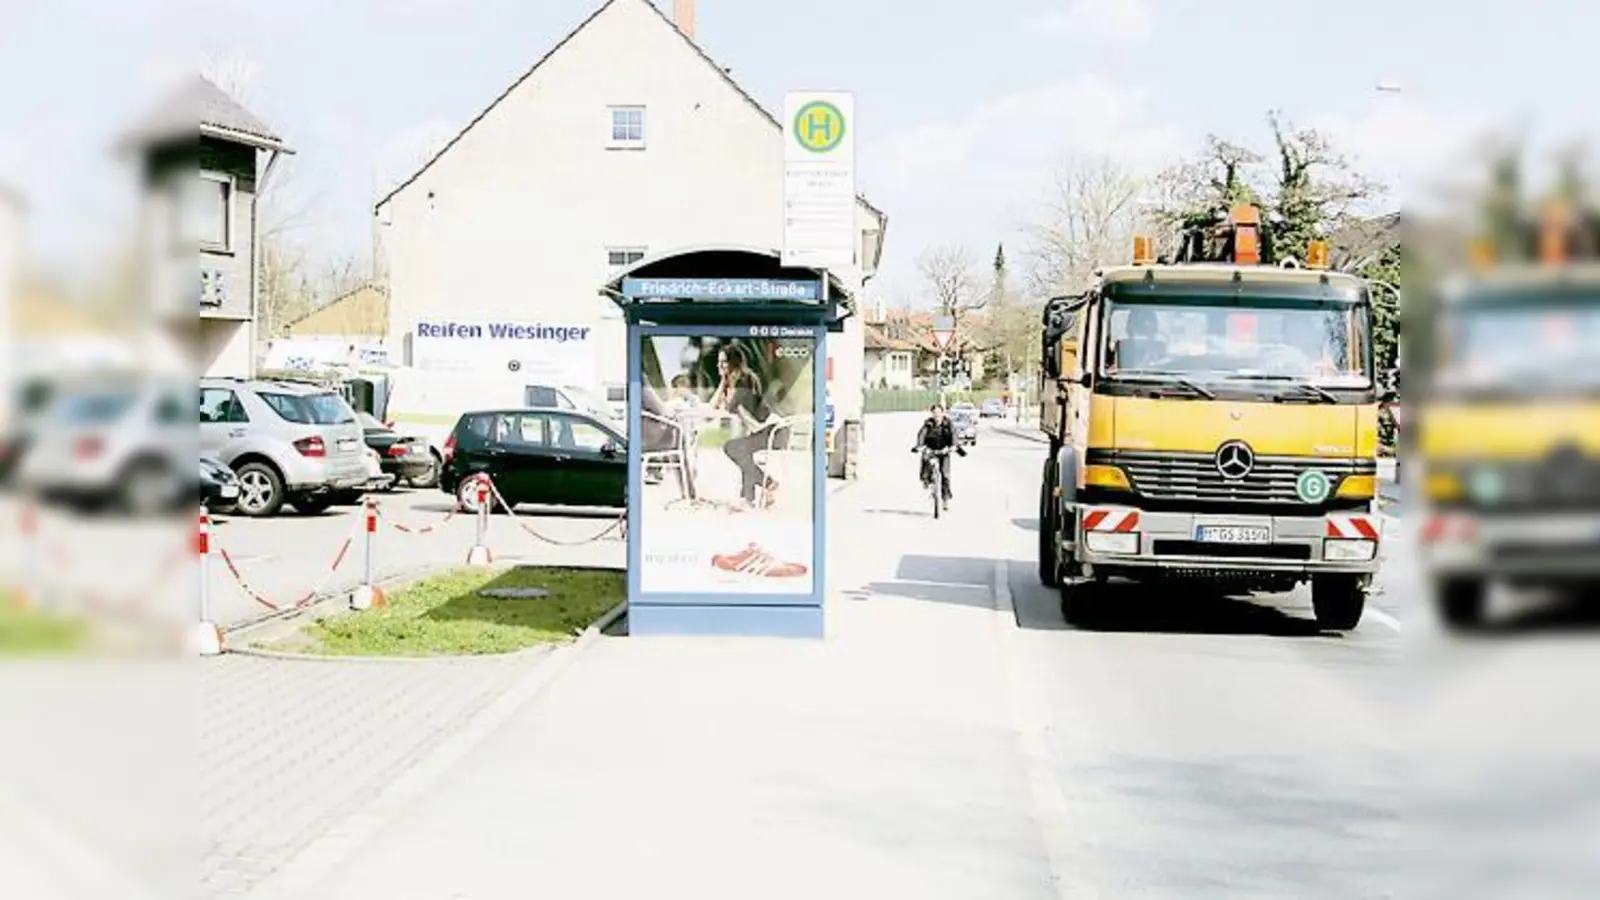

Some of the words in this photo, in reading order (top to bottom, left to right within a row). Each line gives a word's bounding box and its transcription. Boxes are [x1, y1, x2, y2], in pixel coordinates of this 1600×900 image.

[808, 113, 831, 140] H
[641, 281, 806, 297] Friedrich-Eckart-Straße
[417, 322, 482, 338] Reifen
[488, 323, 590, 343] Wiesinger
[1307, 477, 1321, 496] G
